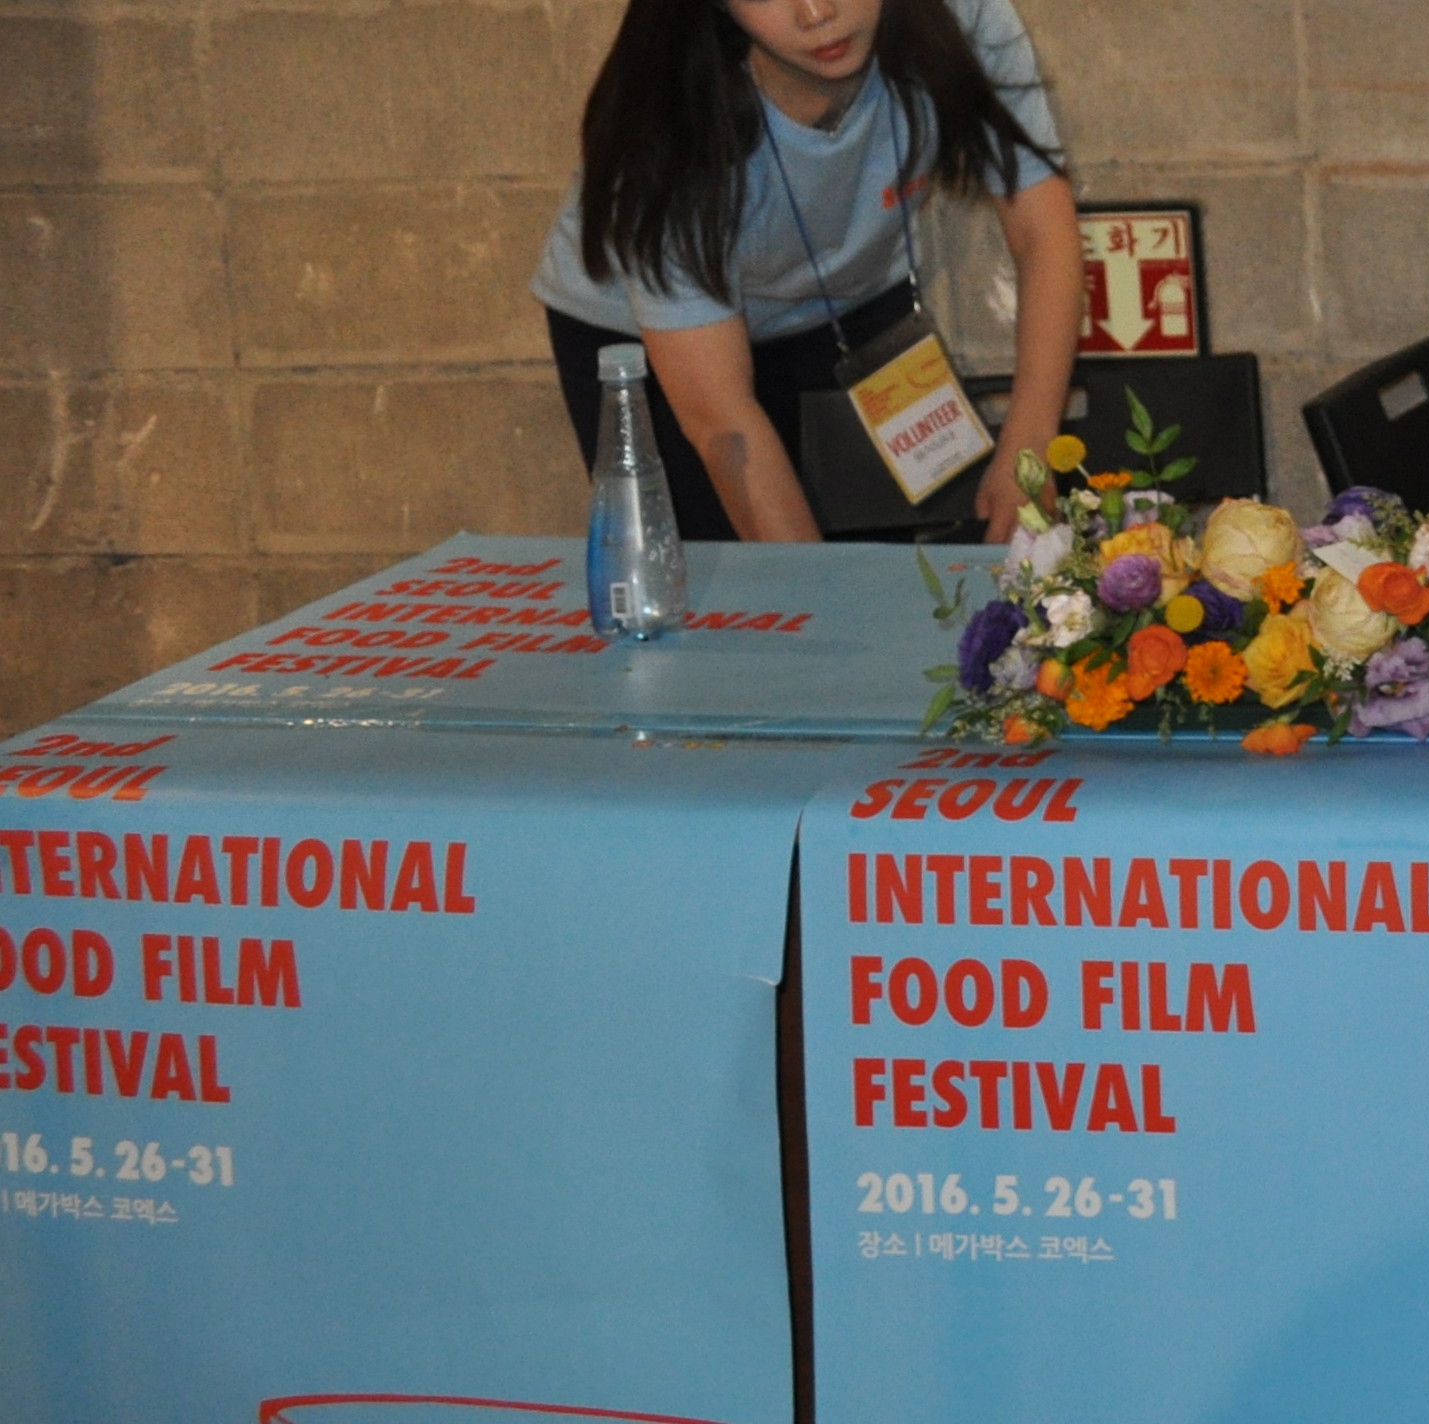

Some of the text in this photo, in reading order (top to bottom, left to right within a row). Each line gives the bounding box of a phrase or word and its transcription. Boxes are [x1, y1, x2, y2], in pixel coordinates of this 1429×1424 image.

[886, 397, 964, 459] VOLUNTEER
[428, 556, 564, 576] 2nd
[373, 579, 565, 601] SEOUL
[265, 626, 611, 655] FOOD FILM
[205, 651, 500, 680] FESTIVAL
[4, 733, 180, 758] 2nd
[900, 748, 1058, 771] 2nd
[849, 778, 1085, 823] SEOUL
[0, 829, 477, 915] TERNATIONAL
[140, 933, 302, 1009] FILM
[849, 955, 1258, 1034] FOOD FILM
[852, 1057, 1178, 1135] FESTIVAL
[69, 1135, 107, 1179] 5.
[113, 1139, 236, 1187] 26-31
[12, 1188, 181, 1226] 메가박스 코엑스
[856, 1172, 1178, 1220] 2016. 5. 26-31
[856, 1230, 1116, 1265] 장소 메가박스 코엑스
